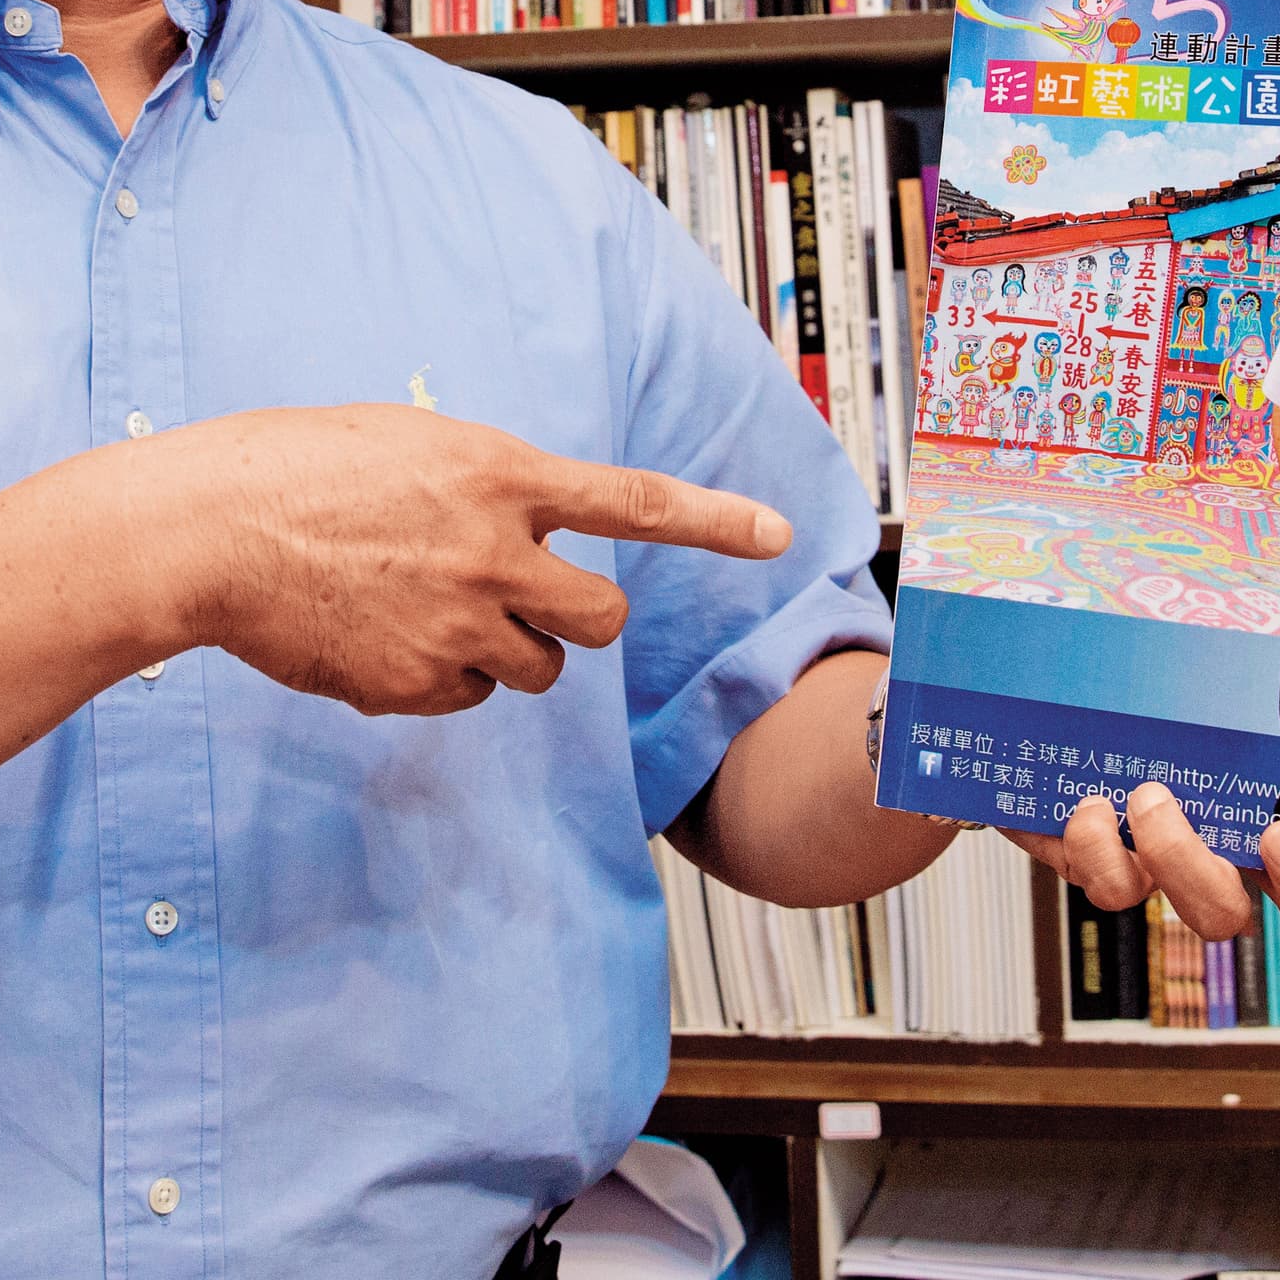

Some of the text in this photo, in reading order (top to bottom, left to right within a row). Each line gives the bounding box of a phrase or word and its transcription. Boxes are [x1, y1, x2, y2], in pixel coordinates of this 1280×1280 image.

[948, 305, 976, 327] 33
[1070, 291, 1098, 314] 25
[1123, 261, 1157, 327] 五六巷
[1116, 344, 1152, 418] 春安路
